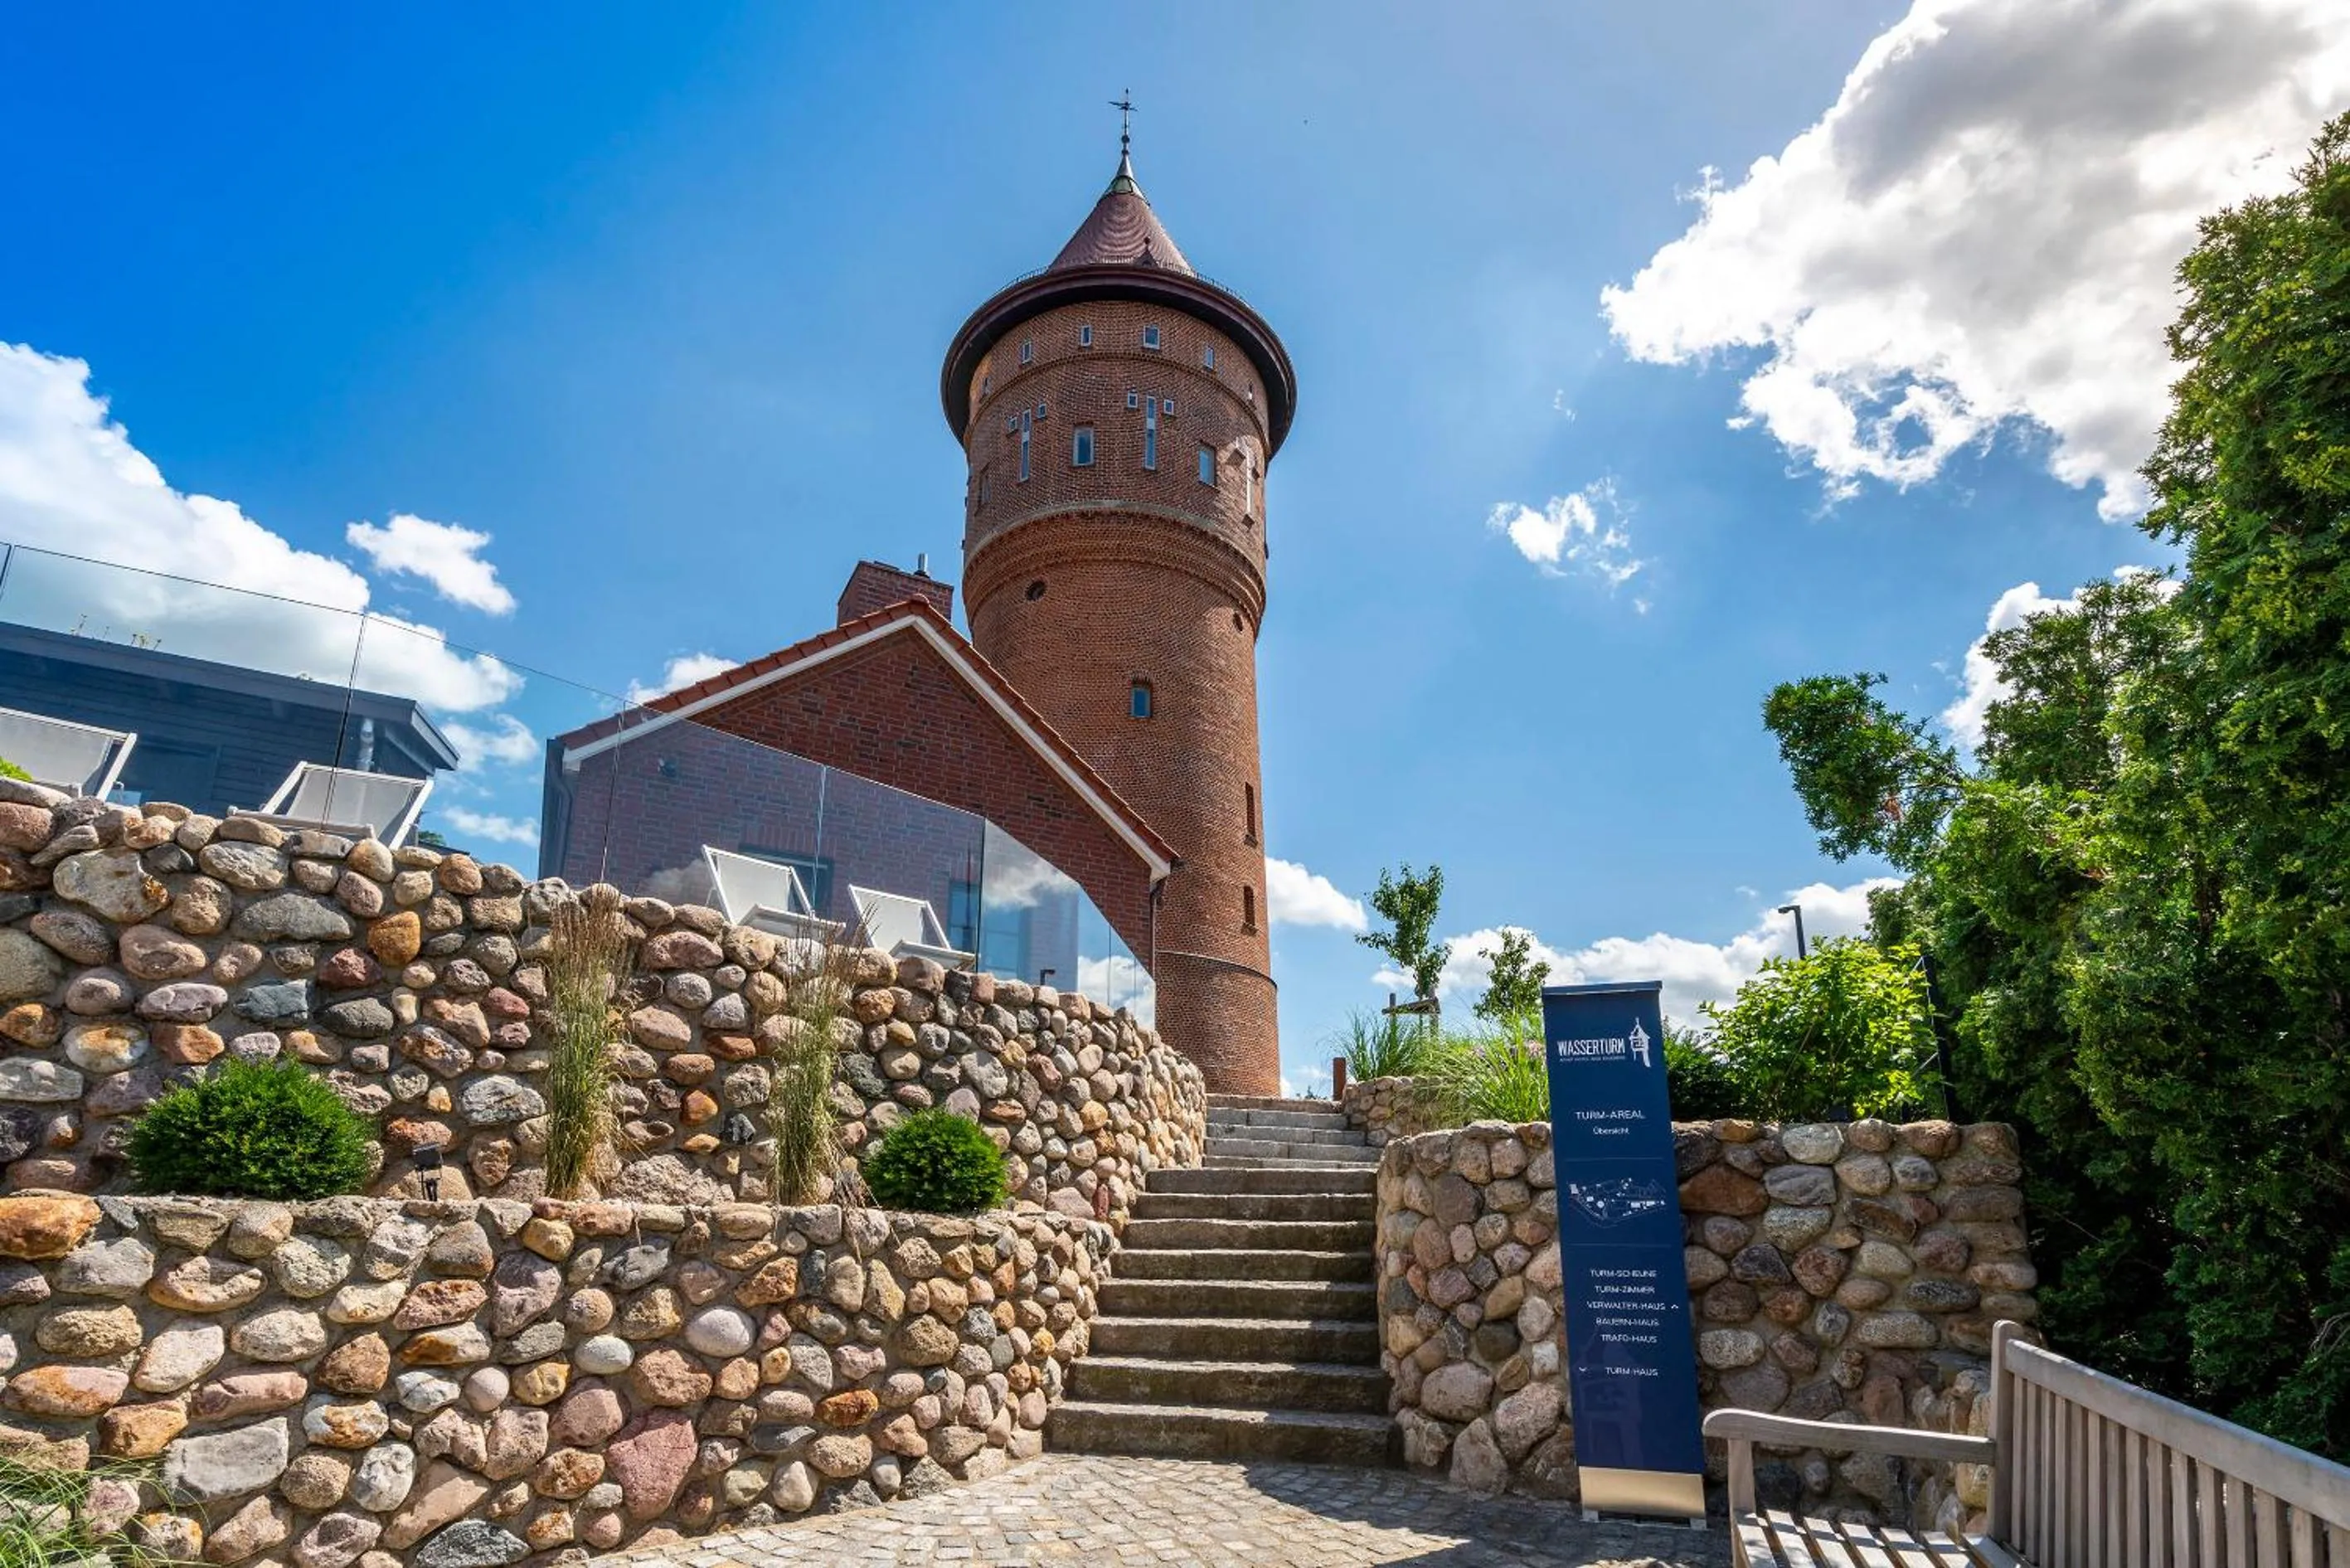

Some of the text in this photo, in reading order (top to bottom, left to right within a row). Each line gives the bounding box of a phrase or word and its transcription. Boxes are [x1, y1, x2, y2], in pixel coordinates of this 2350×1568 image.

[1557, 1038, 1625, 1056] WASSERTURM
[1576, 1109, 1644, 1119] TURM-AREAL
[1593, 1126, 1629, 1134] Übersicht
[1595, 1285, 1655, 1294] TURM-ZIMMER
[1587, 1301, 1666, 1311] VERWALTER-HAUS
[1595, 1318, 1659, 1327] BAUERN-HAUS
[1600, 1333, 1658, 1343] TRAFO-HAUS
[1605, 1367, 1658, 1376] TURM-HAUS
